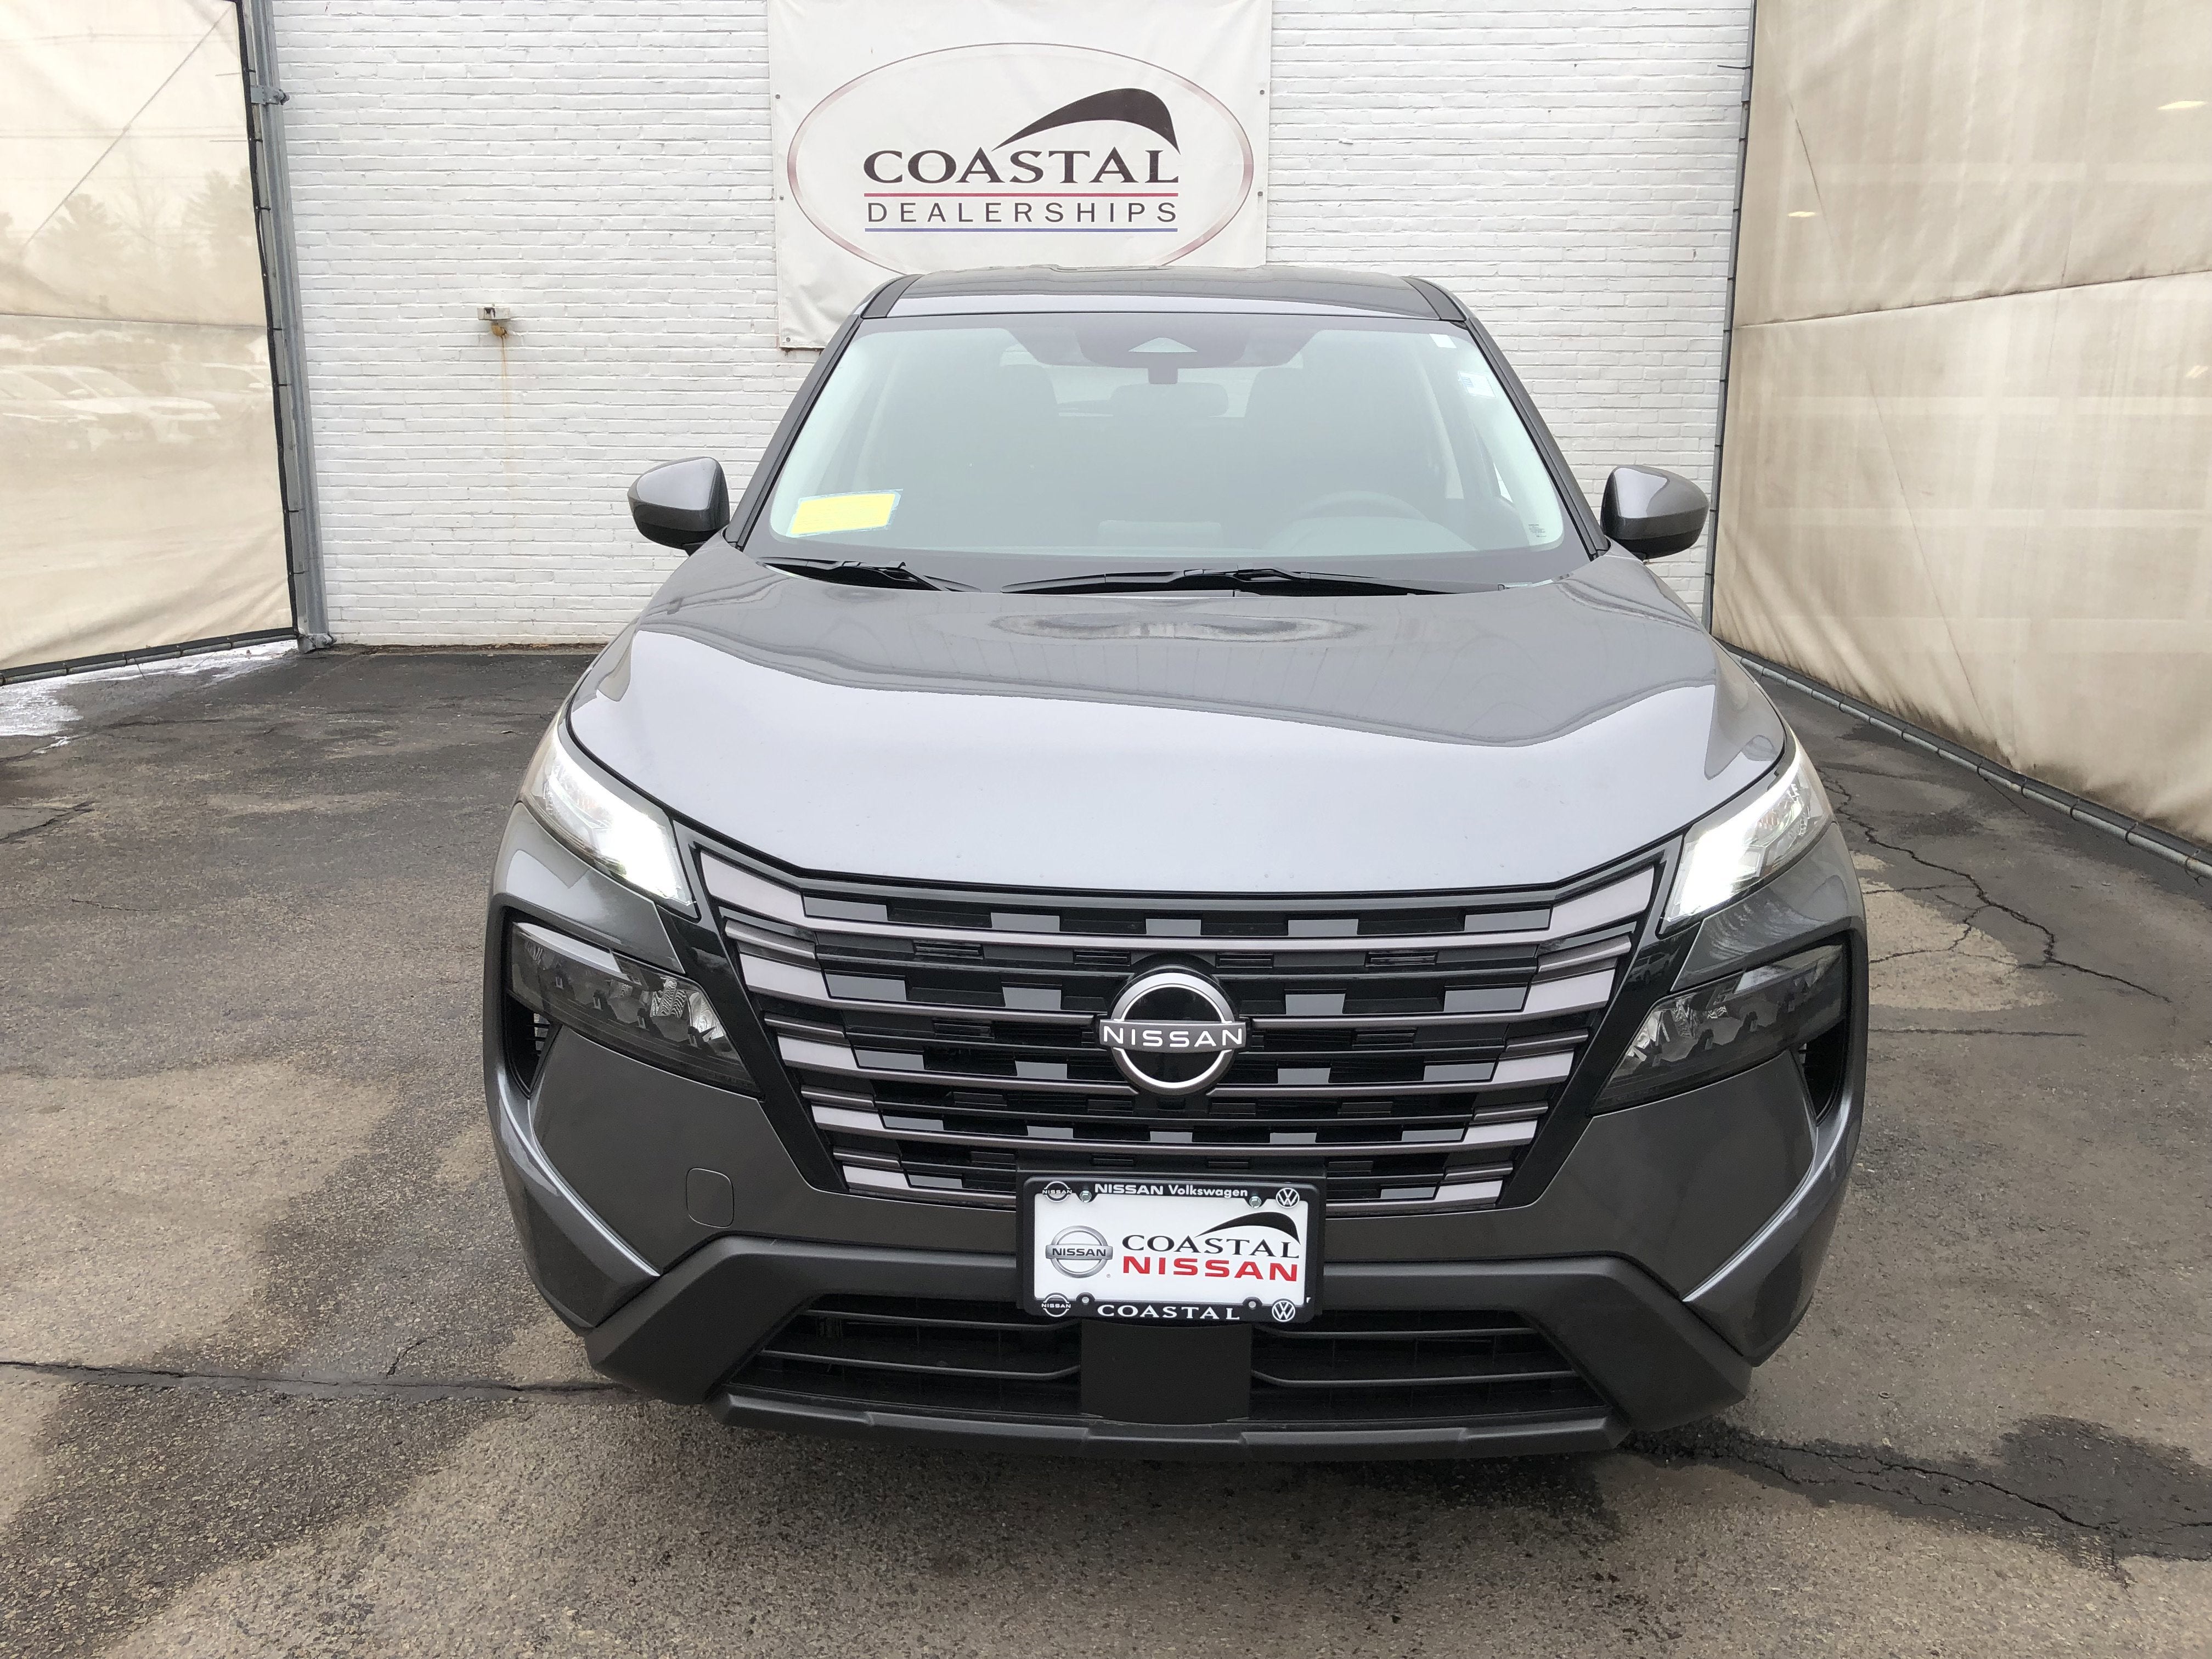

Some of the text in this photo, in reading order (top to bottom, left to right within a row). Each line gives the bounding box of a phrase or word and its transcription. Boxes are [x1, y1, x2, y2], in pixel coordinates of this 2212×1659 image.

[863, 146, 1178, 184] COASTAL
[868, 202, 1177, 222] DEALERSHIPS
[1103, 1025, 1242, 1047] NISSAN
[1094, 1183, 1248, 1198] NISSAN Volkswagen
[1052, 1248, 1106, 1256] NISSAN
[1122, 1234, 1300, 1259] COASTAL
[1123, 1256, 1297, 1282] NISSAN
[1097, 1304, 1240, 1320] COASTAL
